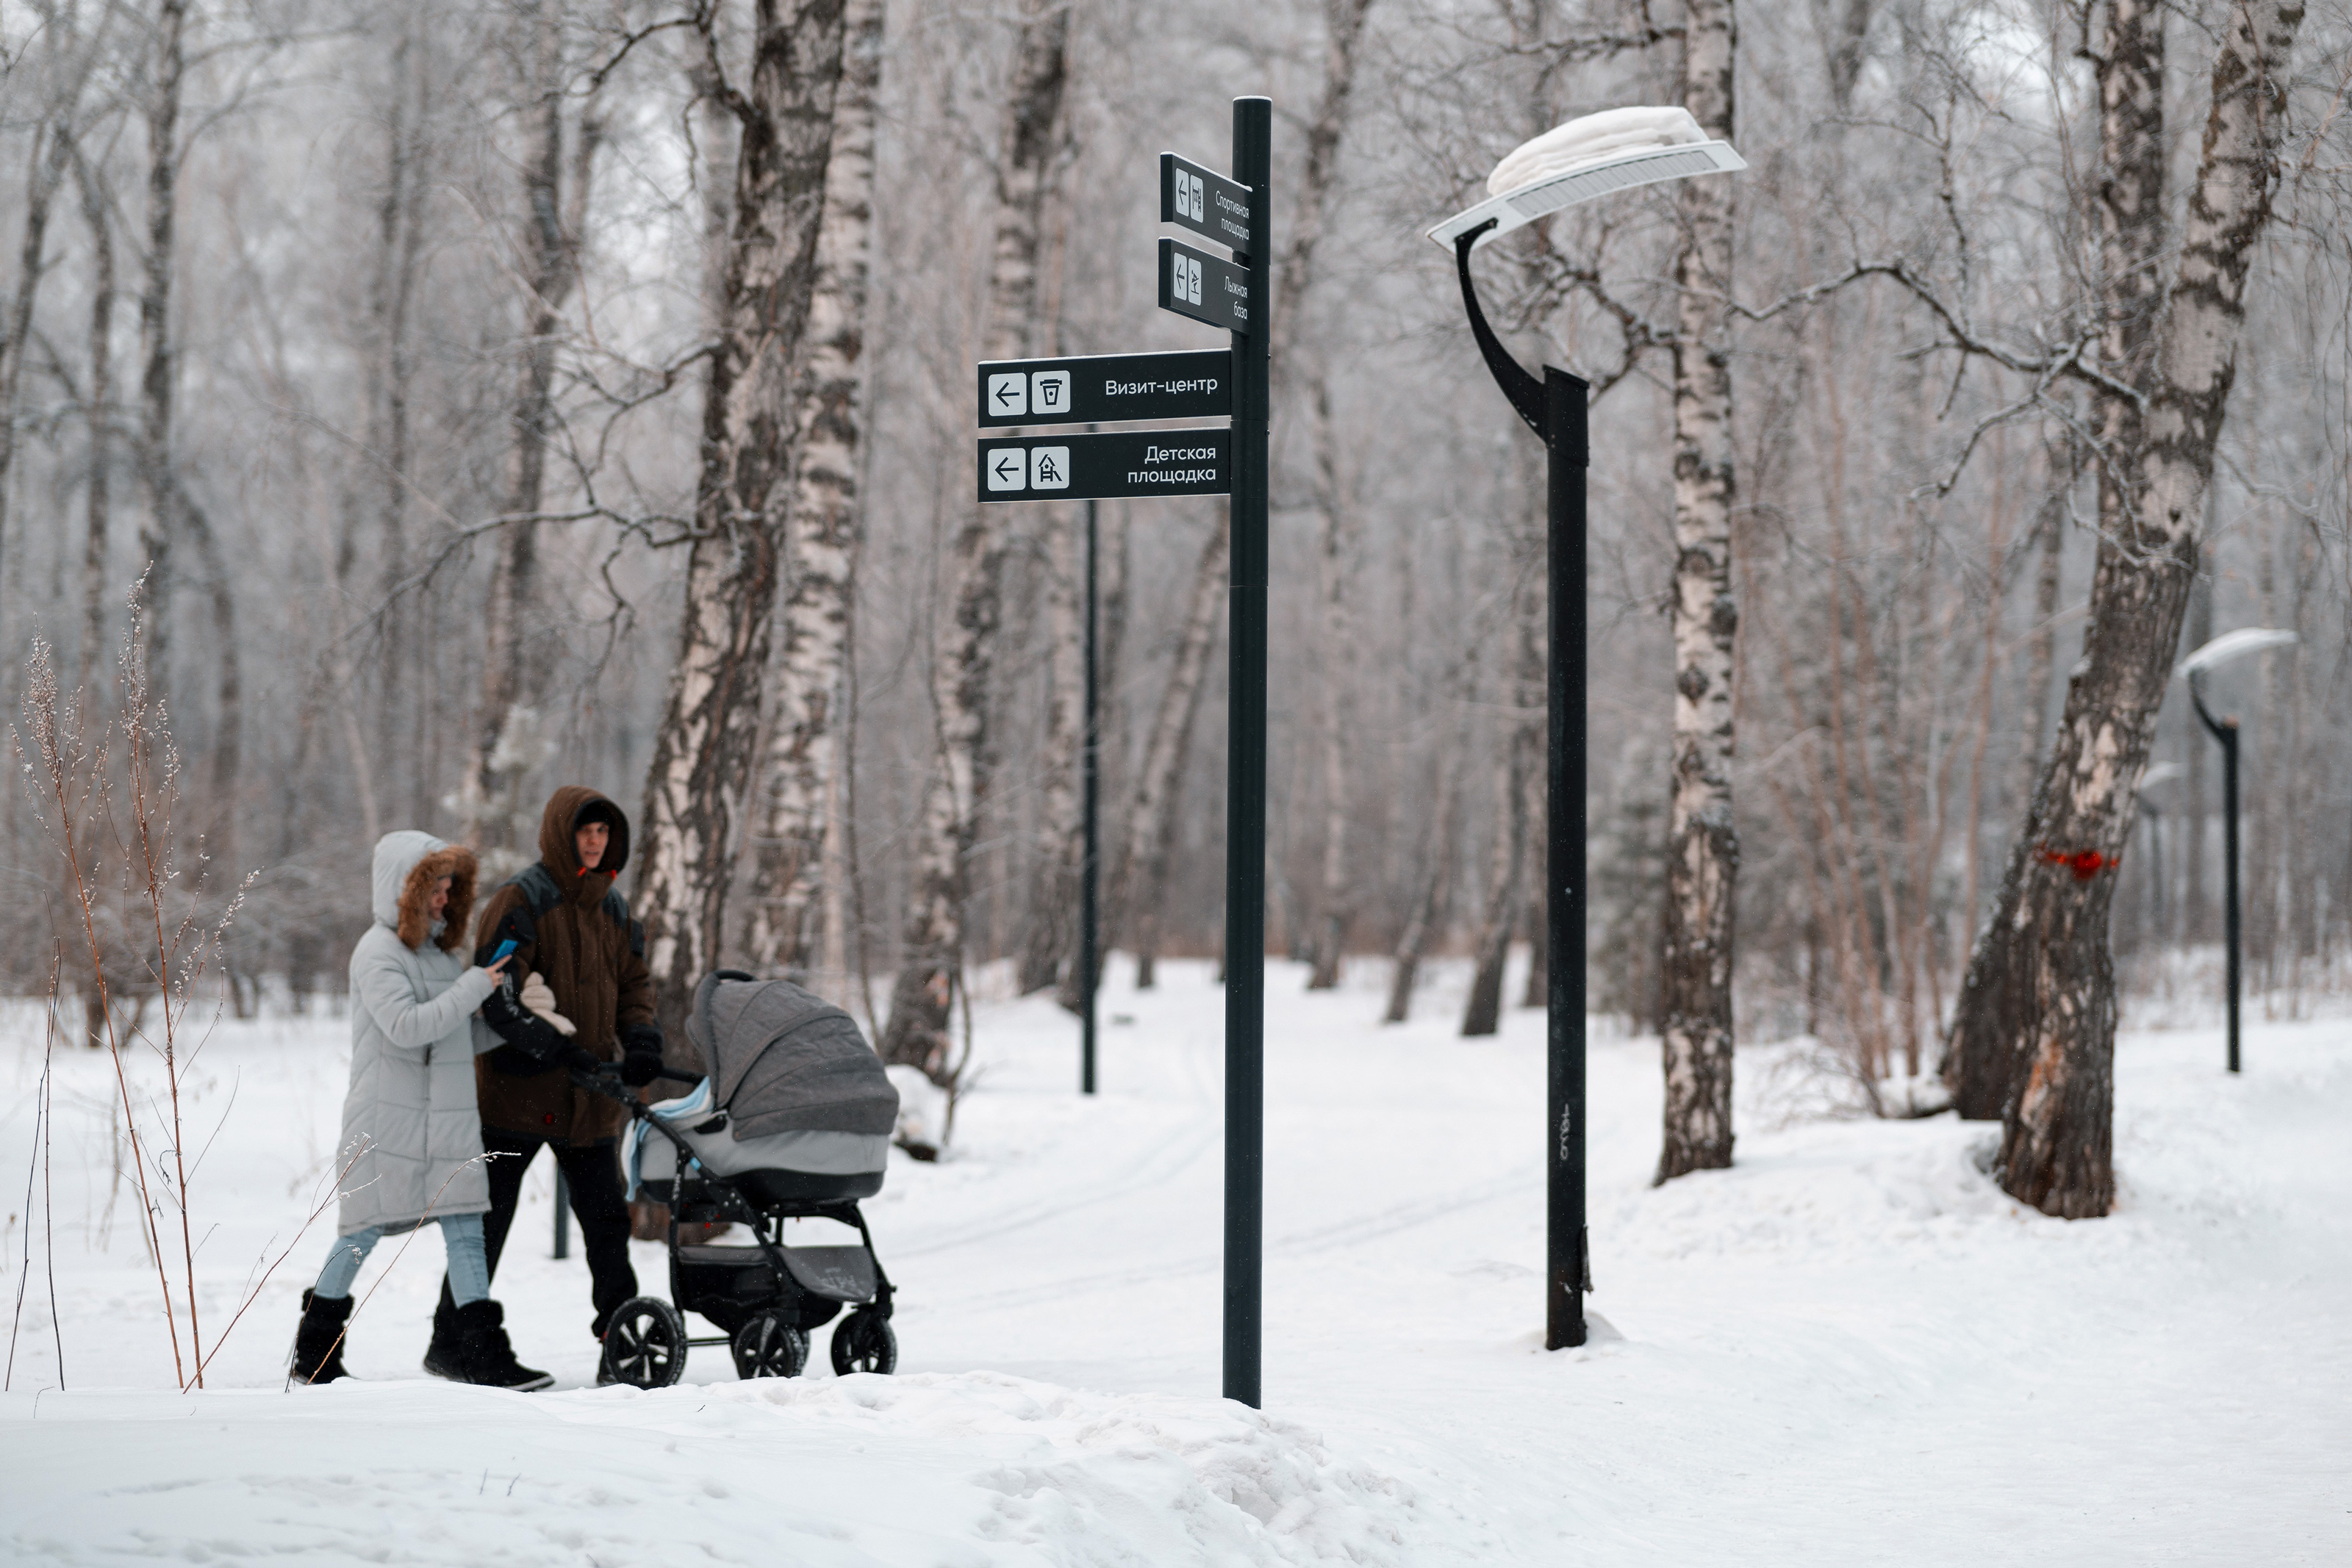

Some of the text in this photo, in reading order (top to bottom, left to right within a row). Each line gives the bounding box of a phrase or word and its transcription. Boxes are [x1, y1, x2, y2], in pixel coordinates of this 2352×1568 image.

[1216, 190, 1249, 219] Спортивная
[1221, 217, 1249, 240] площадка
[1225, 276, 1247, 298] Лыжная
[1233, 301, 1247, 320] база
[1105, 378, 1218, 395] Визит-центр
[1144, 446, 1216, 464] Детская
[1127, 469, 1216, 484] площадка
